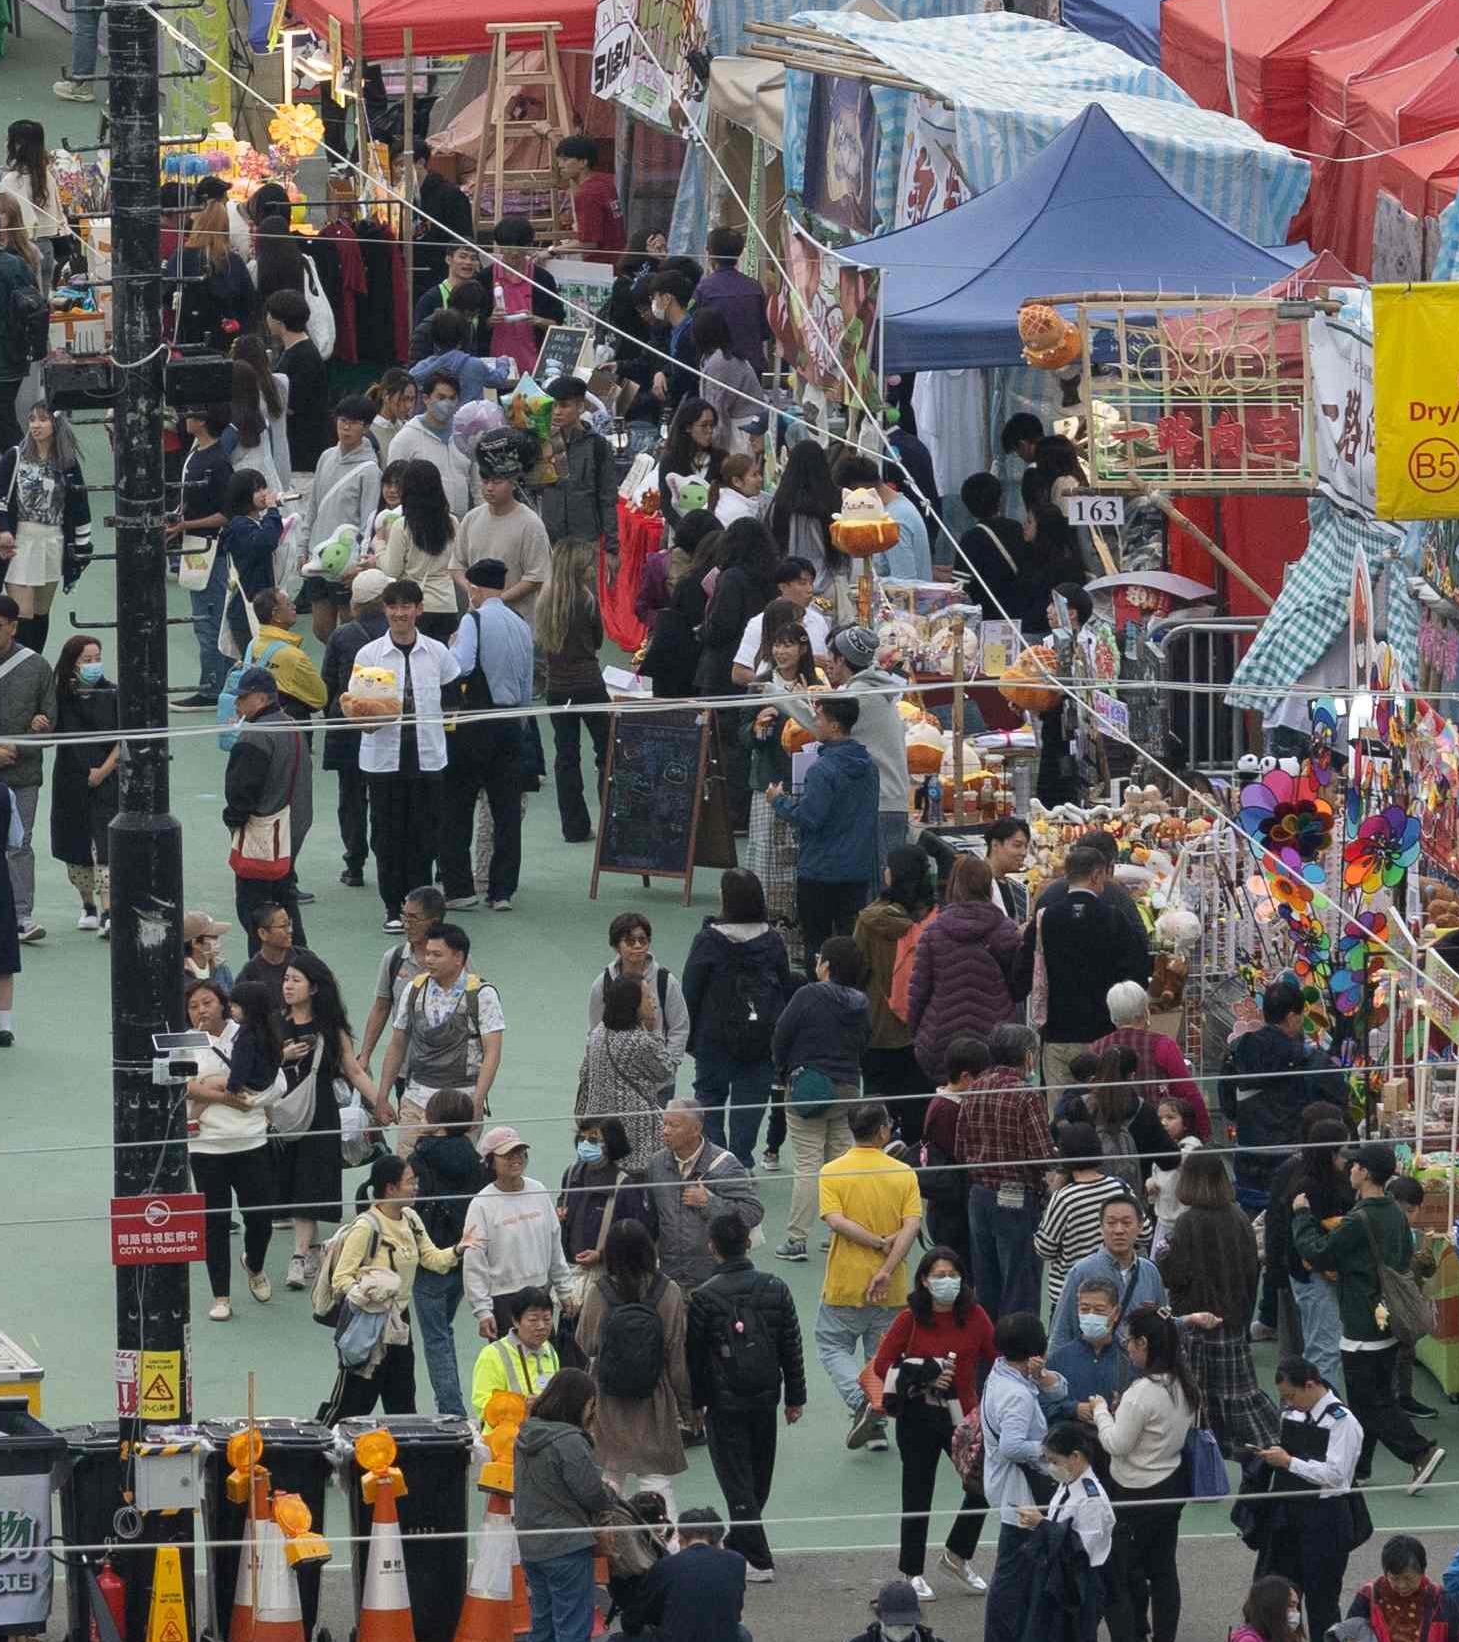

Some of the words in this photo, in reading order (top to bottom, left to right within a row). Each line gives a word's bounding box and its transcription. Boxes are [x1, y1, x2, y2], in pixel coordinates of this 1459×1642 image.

[1416, 452, 1457, 479] B5
[1076, 500, 1118, 521] 163
[119, 1245, 144, 1255] CCTV
[146, 1245, 155, 1254] in
[156, 1243, 198, 1255] Operation
